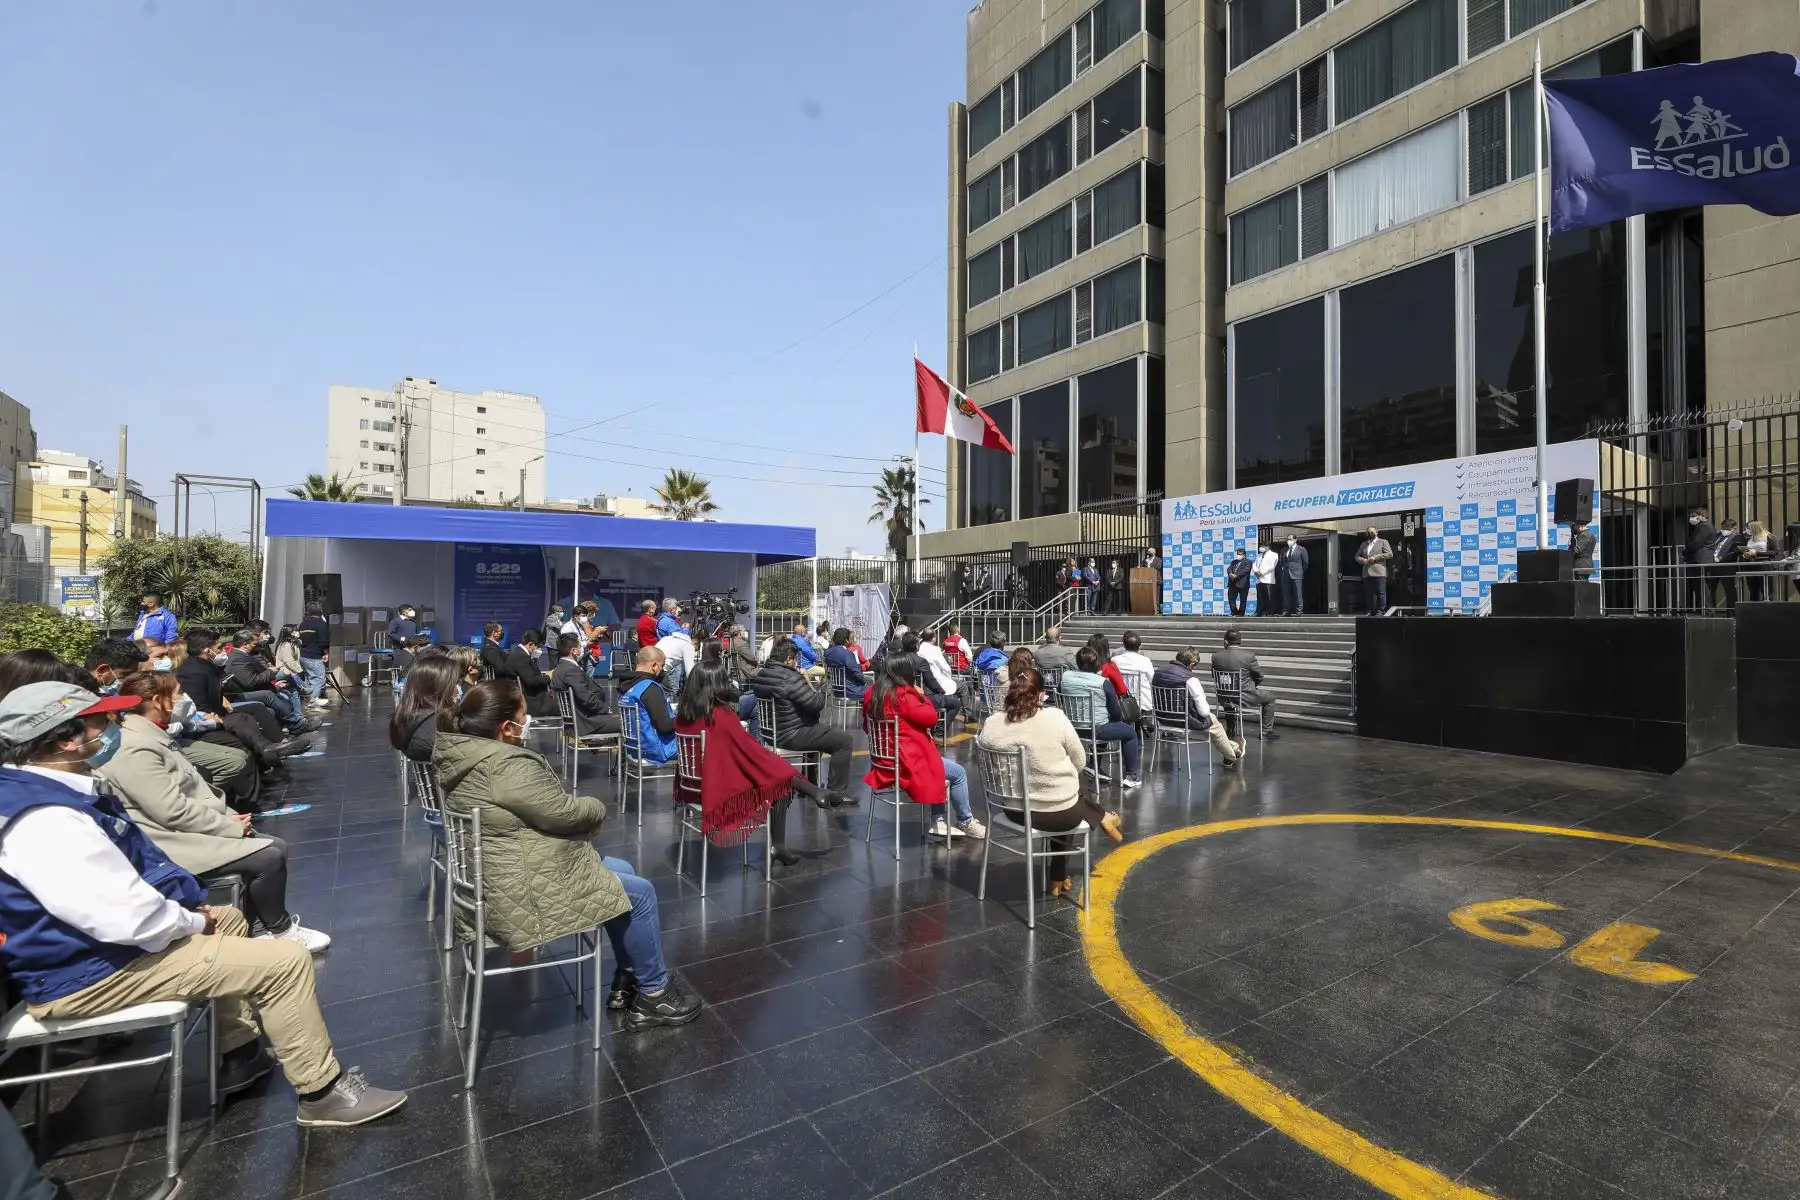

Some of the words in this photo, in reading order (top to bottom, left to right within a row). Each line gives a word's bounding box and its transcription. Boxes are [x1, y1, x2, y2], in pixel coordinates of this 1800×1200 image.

[1630, 136, 1790, 179] EsSalud
[1507, 454, 1537, 463] primar
[1274, 495, 1334, 510] RECUPERA
[1338, 493, 1345, 503] Y
[1348, 486, 1413, 501] FORTALECE
[1468, 489, 1508, 499] Recursos
[1509, 485, 1552, 494] humans
[1200, 499, 1251, 518] EsSalud
[1217, 515, 1251, 525] saludable
